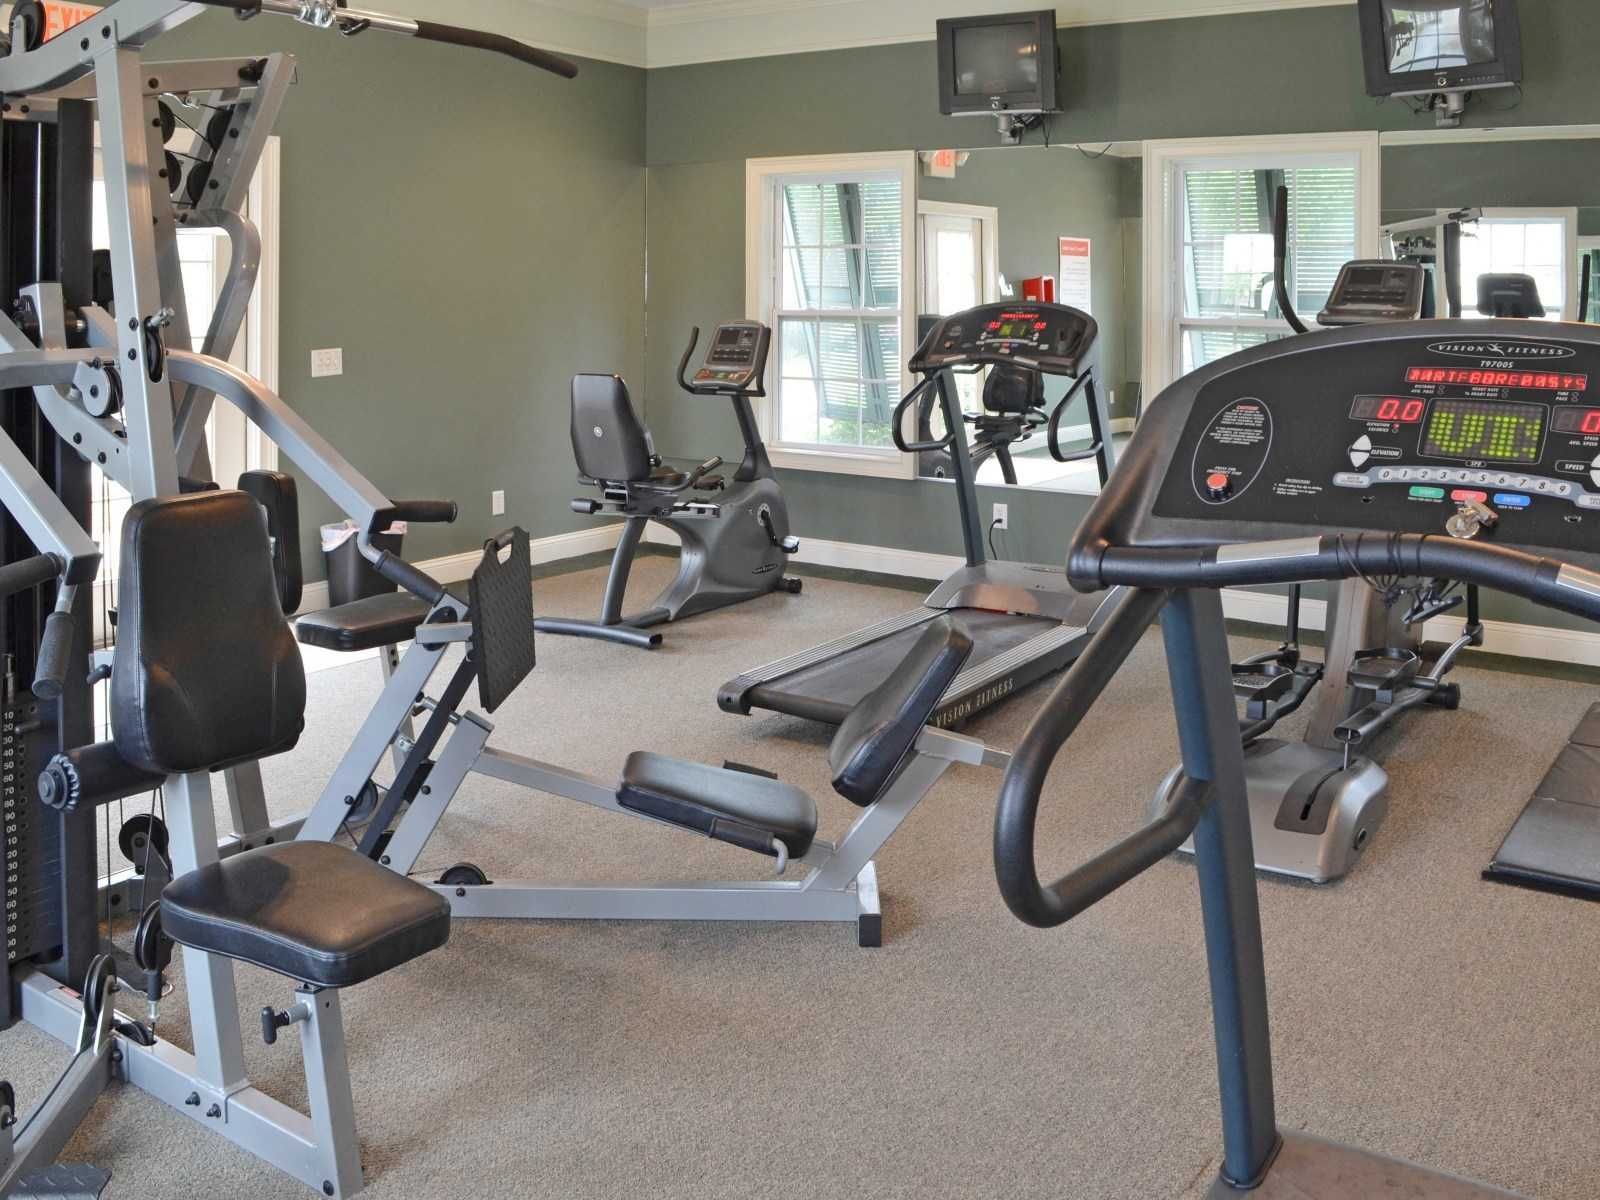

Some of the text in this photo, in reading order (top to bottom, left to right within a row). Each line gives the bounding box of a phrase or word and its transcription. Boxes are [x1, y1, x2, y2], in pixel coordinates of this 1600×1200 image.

[1438, 344, 1564, 355] VISION FITNESS
[1480, 360, 1514, 369] T9700S
[1564, 463, 1585, 471] SPEED
[1402, 470, 1408, 478] 1
[1421, 470, 1428, 478] 2
[1440, 471, 1447, 479] 3
[1460, 472, 1466, 480] 4
[1498, 476, 1505, 484] 6
[1519, 479, 1527, 487] 7
[1539, 481, 1546, 489] 8
[1559, 485, 1566, 493] 9
[976, 678, 1014, 706] FITNESS
[4, 711, 14, 720] 10
[3, 736, 13, 745] 30
[3, 748, 14, 757] 40
[4, 761, 14, 770] 50
[4, 774, 14, 783] 60
[5, 787, 14, 796] 70
